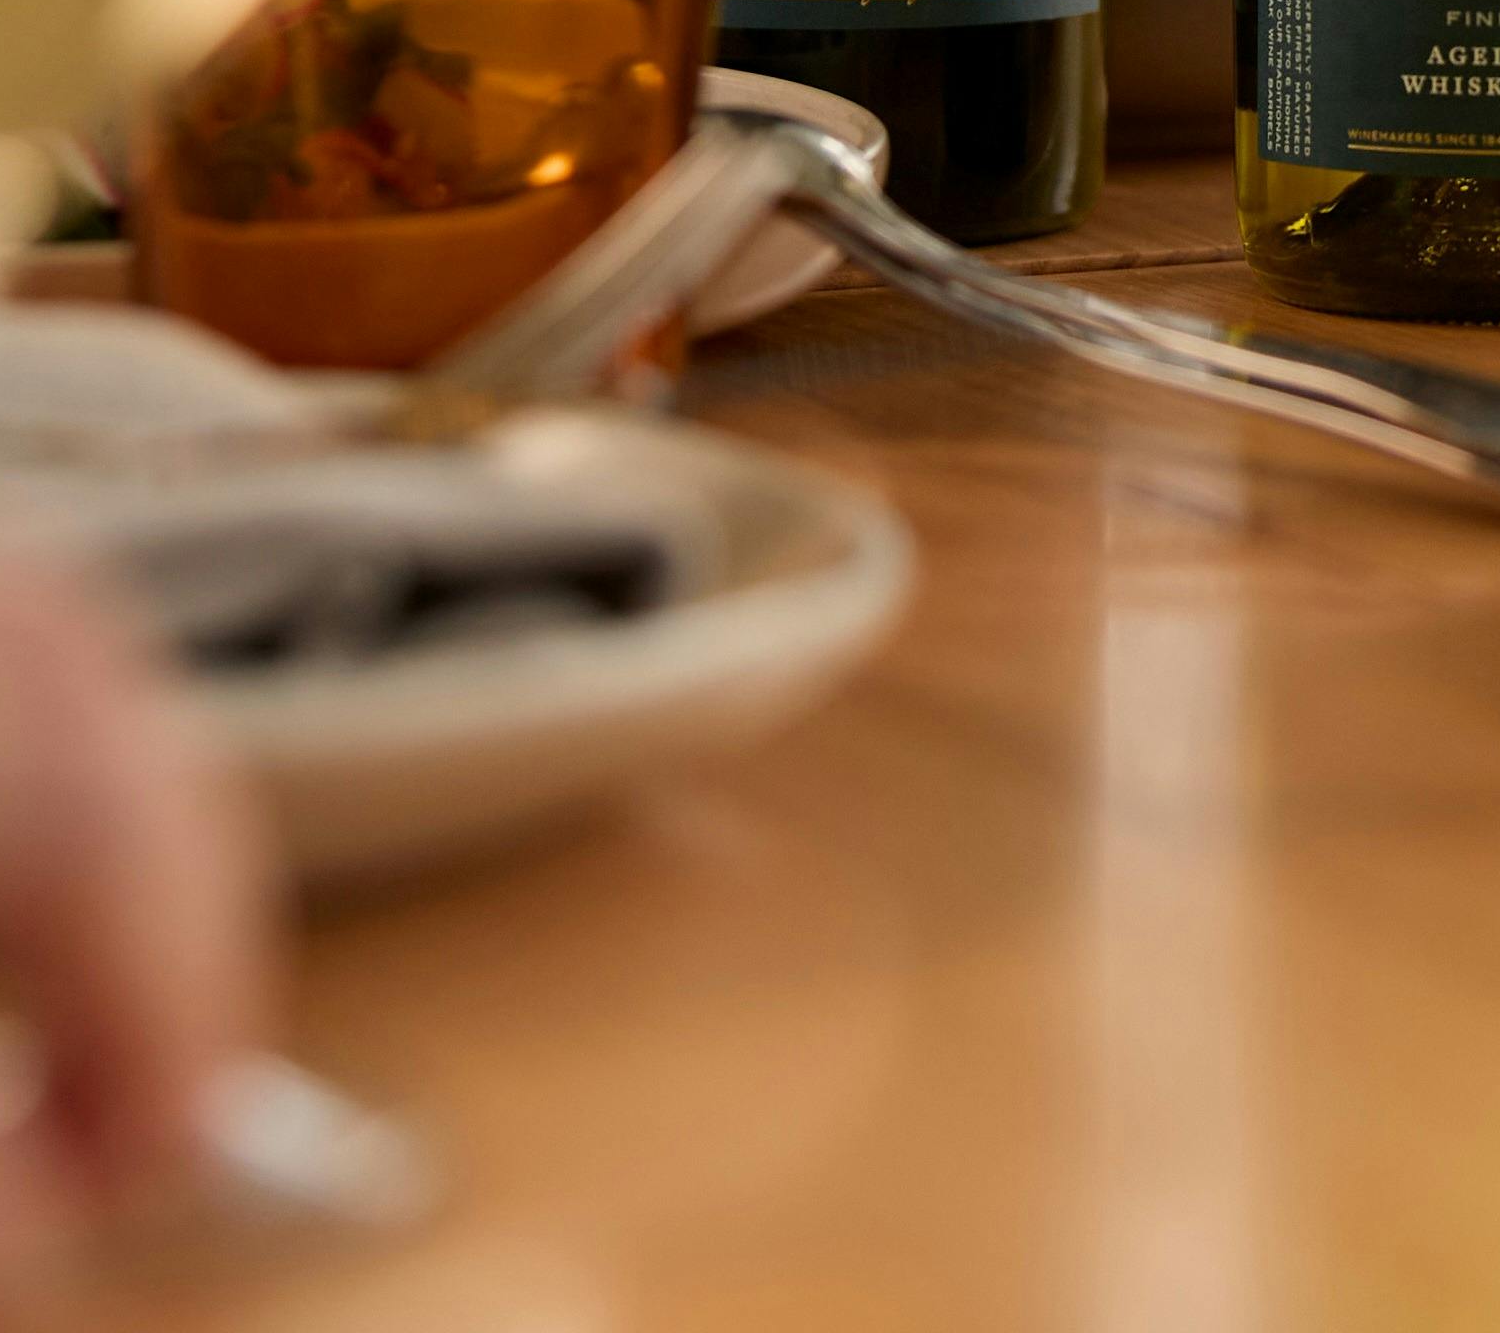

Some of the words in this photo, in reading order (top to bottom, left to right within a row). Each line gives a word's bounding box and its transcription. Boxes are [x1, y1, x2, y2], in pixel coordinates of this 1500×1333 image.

[1267, 28, 1275, 68] WINE
[1275, 8, 1283, 44] OUR
[1284, 23, 1292, 44] UP
[1294, 24, 1302, 74] FIRST
[1284, 50, 1292, 70] TO
[1266, 77, 1274, 151] BARRELS
[1274, 48, 1283, 152] TRADITIONAL
[1283, 93, 1291, 154] MONTHS
[1293, 81, 1302, 156] MATURED
[1303, 80, 1312, 158] CRAFTED
[1347, 128, 1432, 145] WINEMAKERS
[1435, 132, 1478, 146] SINCE
